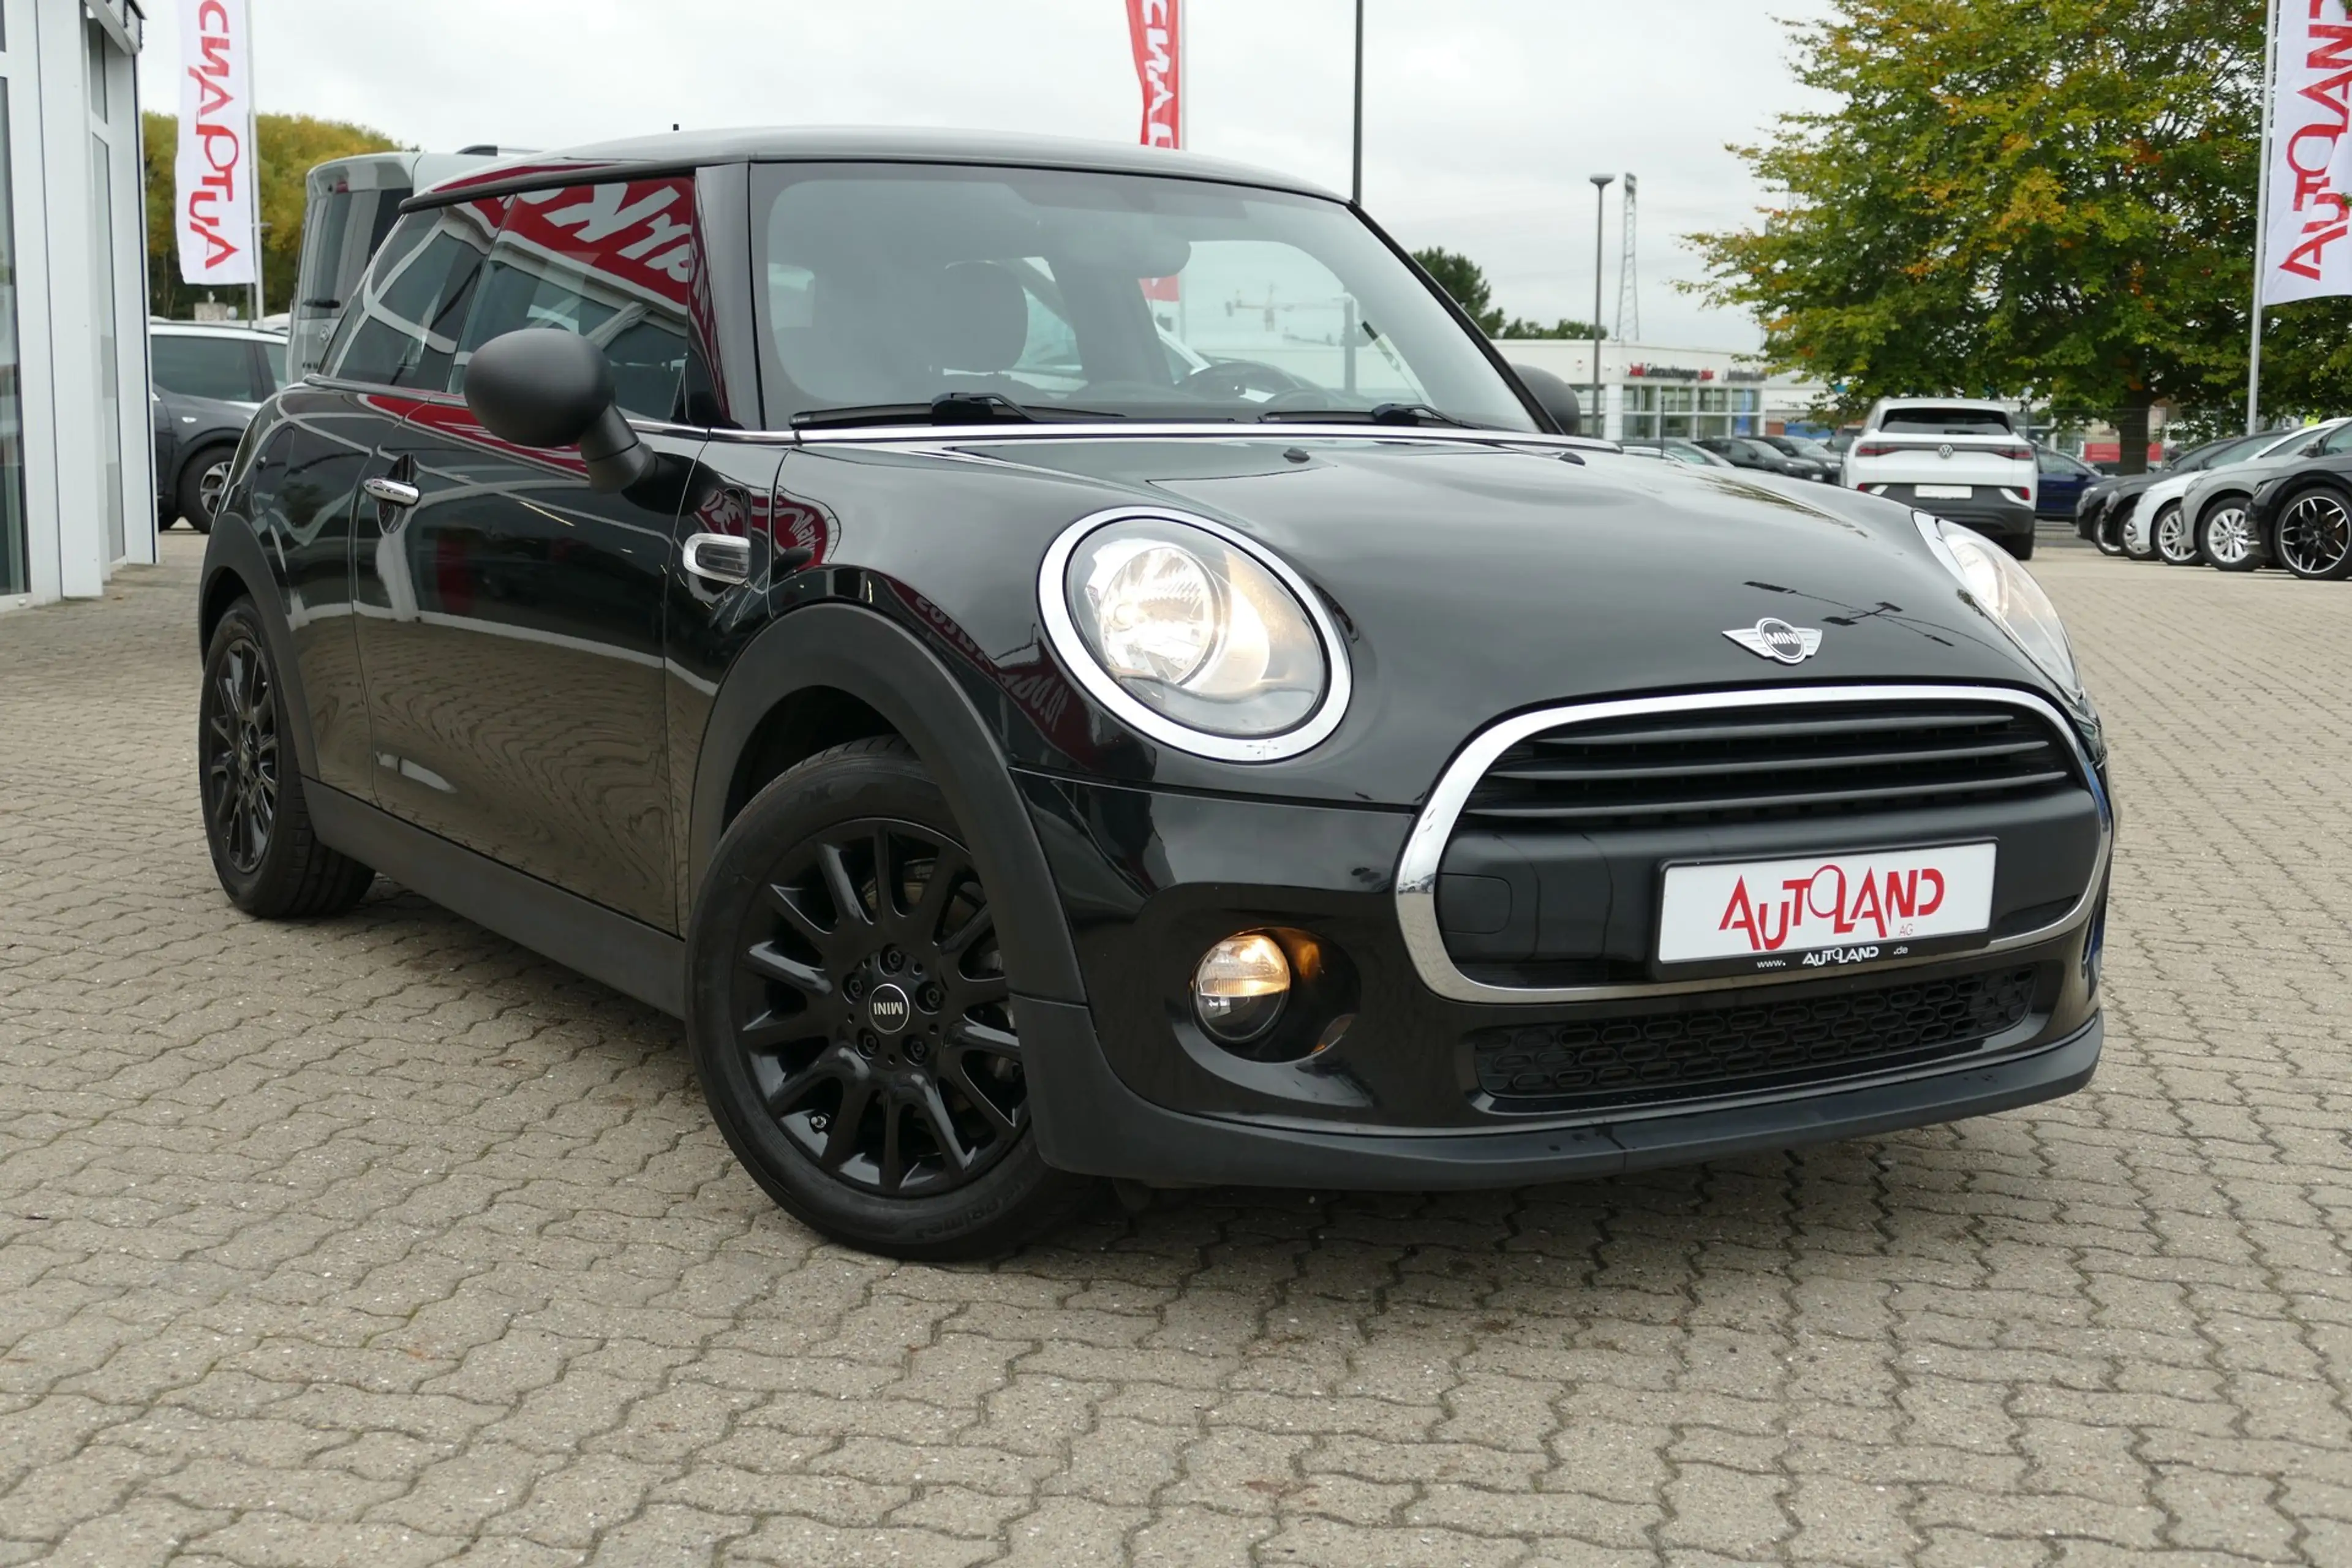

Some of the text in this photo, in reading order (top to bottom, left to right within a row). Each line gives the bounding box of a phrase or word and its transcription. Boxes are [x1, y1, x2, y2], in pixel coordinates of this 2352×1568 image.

[1765, 631, 1801, 645] MINI
[1719, 865, 1945, 951] AUTOLAND
[1899, 923, 1913, 937] AG
[1757, 946, 1909, 968] www. AUTOLAND .de
[873, 1001, 903, 1015] MINI
